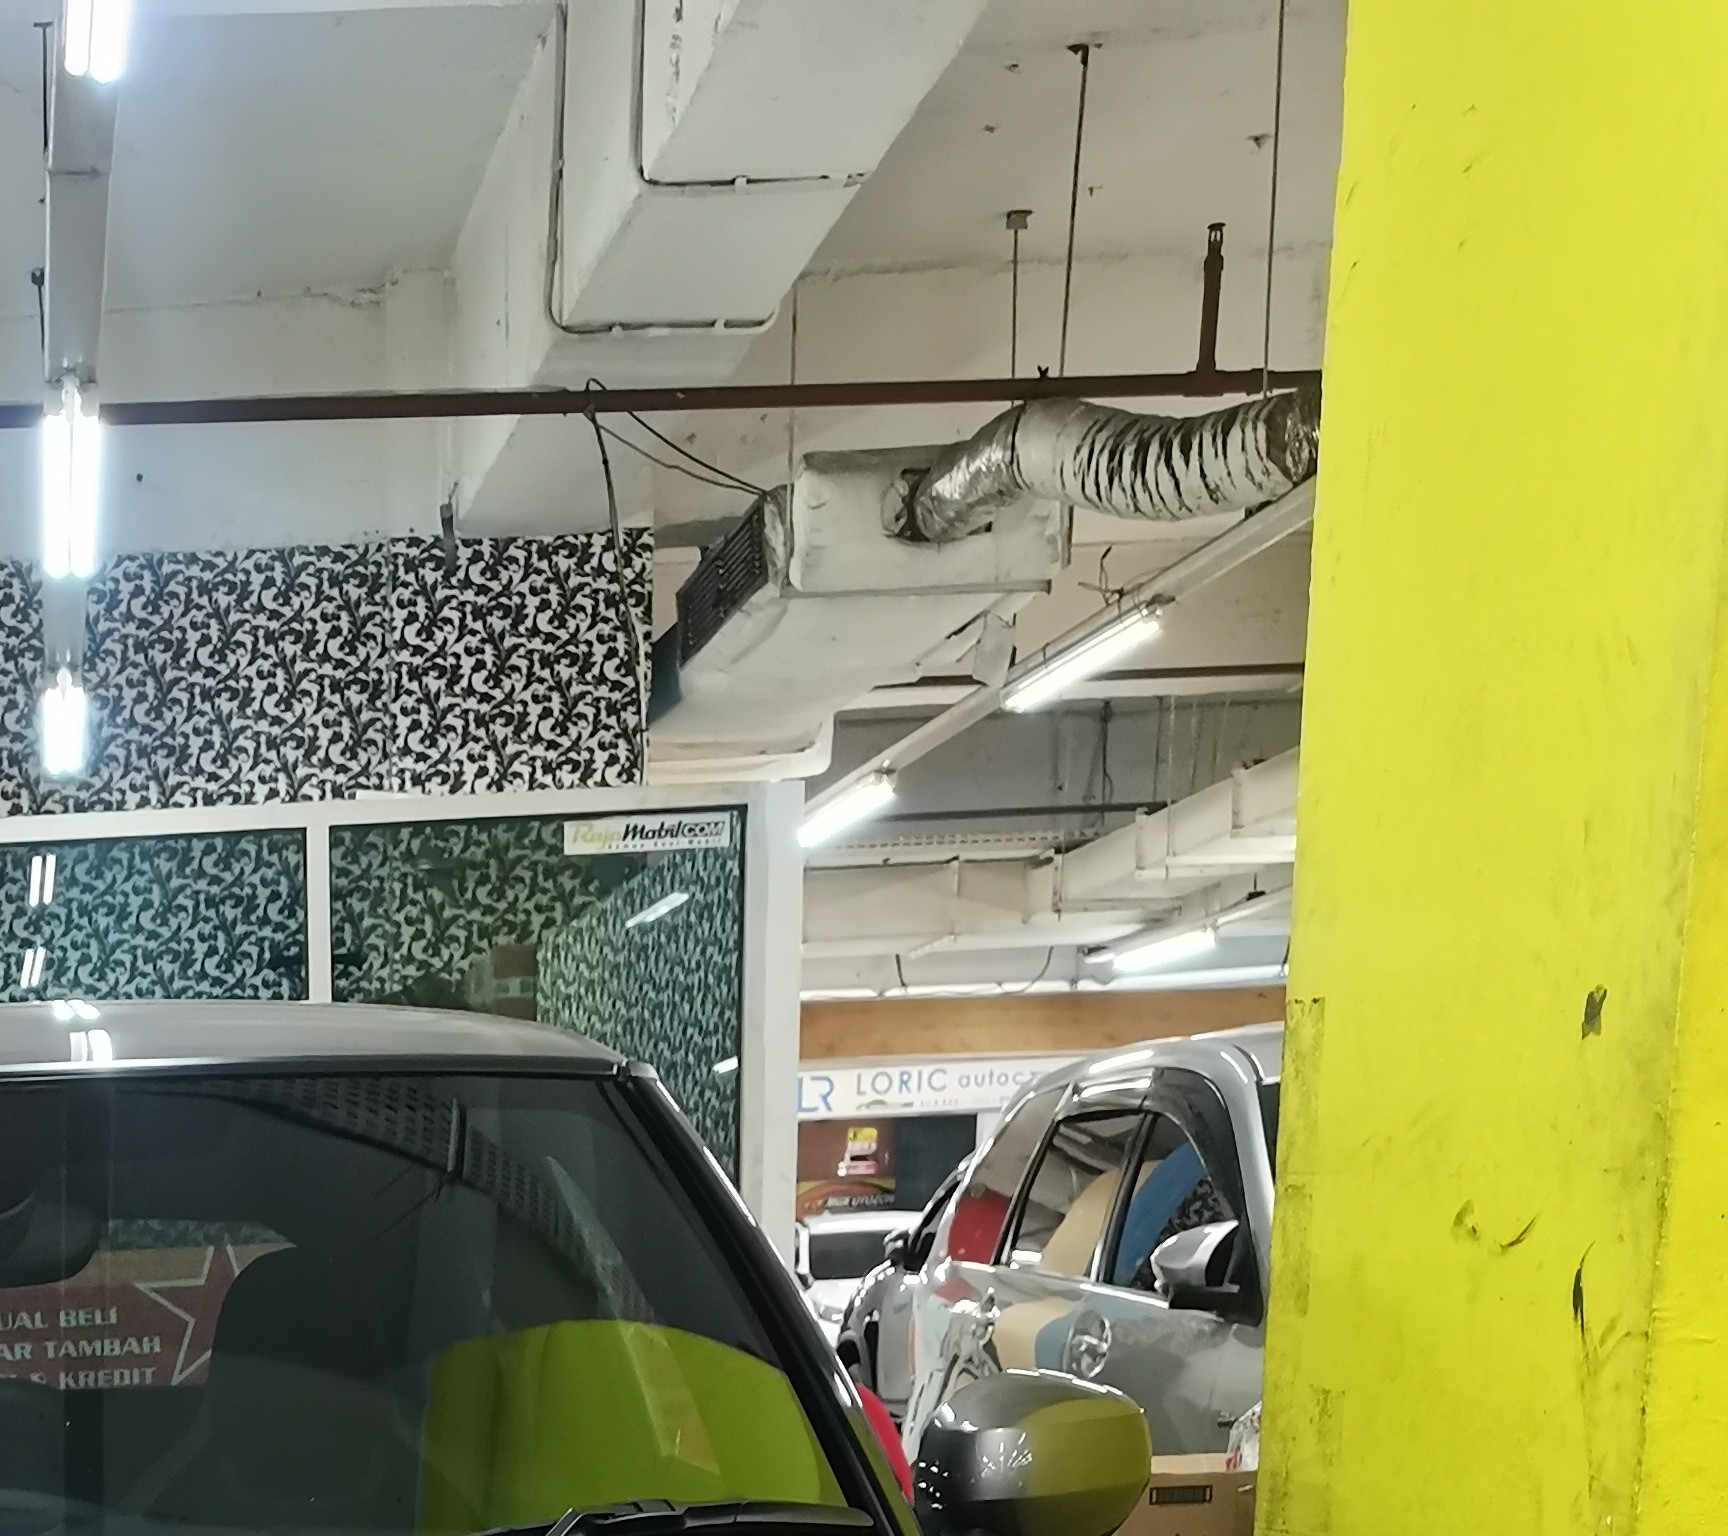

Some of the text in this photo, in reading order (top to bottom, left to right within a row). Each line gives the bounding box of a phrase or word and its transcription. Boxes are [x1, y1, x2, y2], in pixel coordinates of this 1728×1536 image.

[855, 1067, 1042, 1097] LORIC autoc
[59, 1306, 118, 1328] BELI
[43, 1335, 162, 1360] TAMBAH
[57, 1367, 157, 1390] KREDIT
